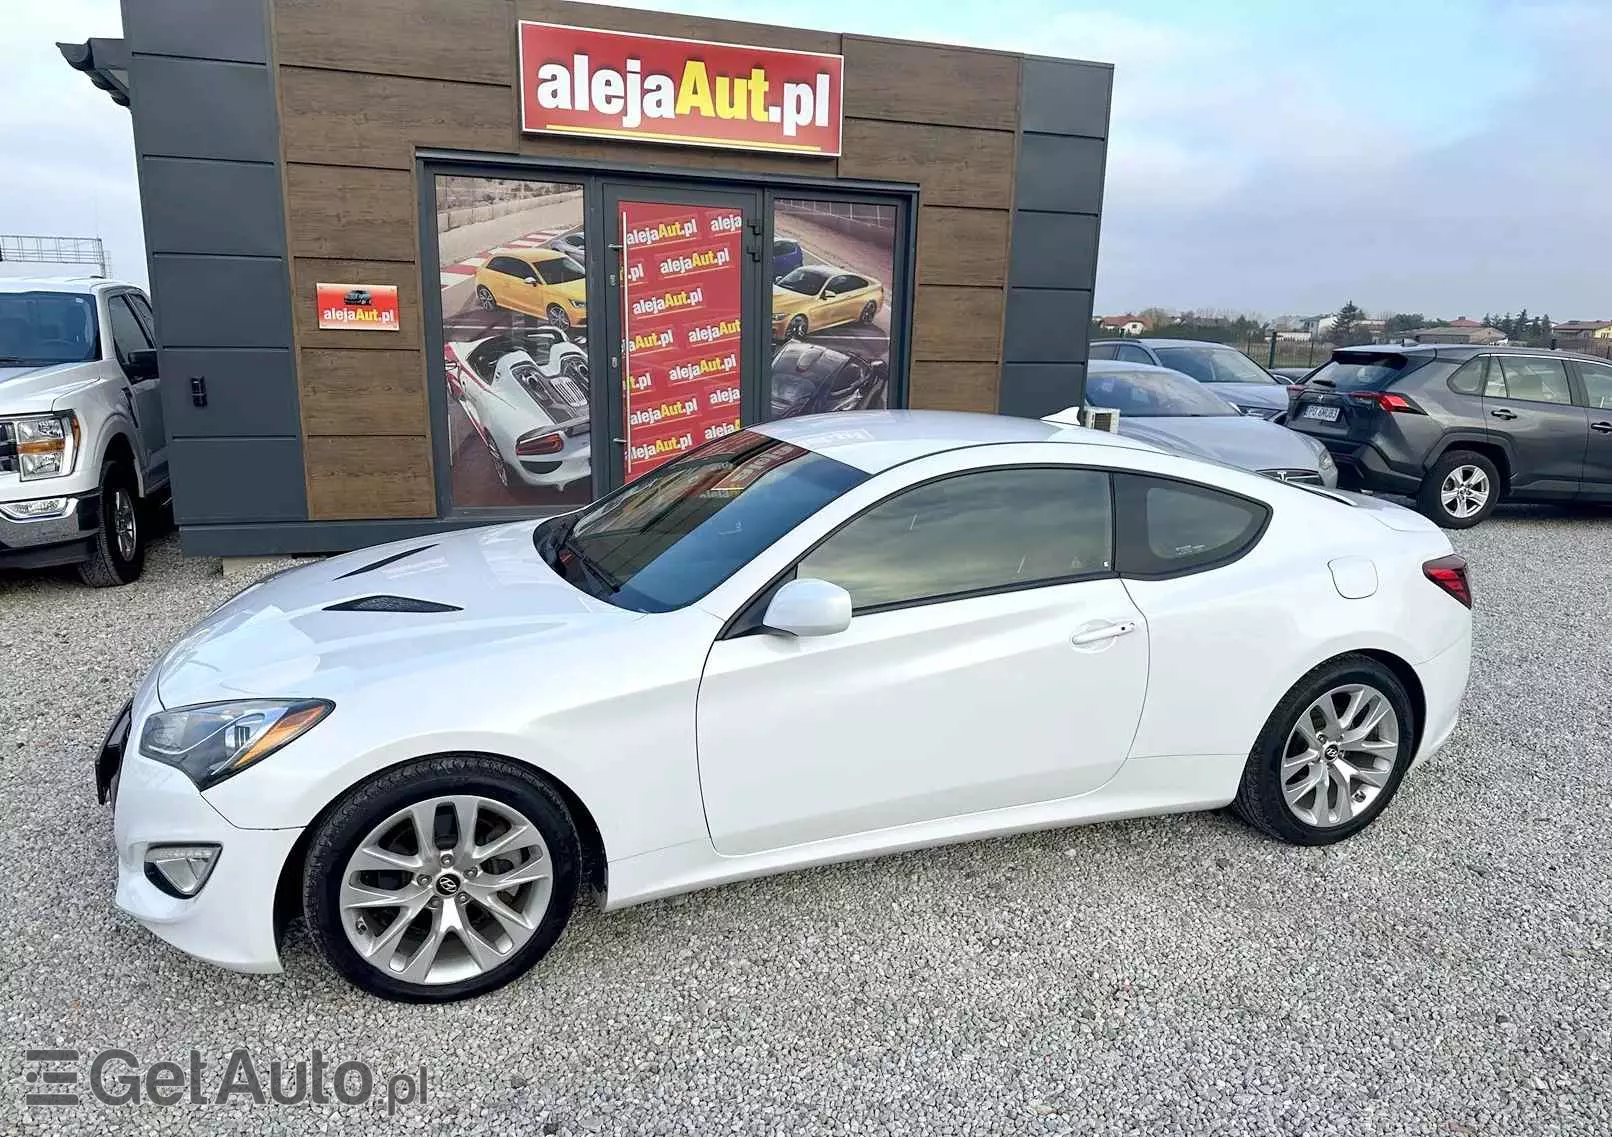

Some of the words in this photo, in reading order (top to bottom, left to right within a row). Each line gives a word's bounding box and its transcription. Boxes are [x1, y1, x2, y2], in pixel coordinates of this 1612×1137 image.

[537, 53, 830, 136] alejaAut.pl
[627, 219, 697, 245] alejaAut.pl
[710, 214, 741, 232] aleja
[659, 248, 730, 274] alejaAut.pl
[632, 287, 703, 314] alejaAut.pl
[323, 307, 395, 323] alejaAut.pl
[668, 354, 737, 381] alejaAut.pl
[630, 398, 698, 425] alejaAut.pl
[710, 387, 741, 404] aleja
